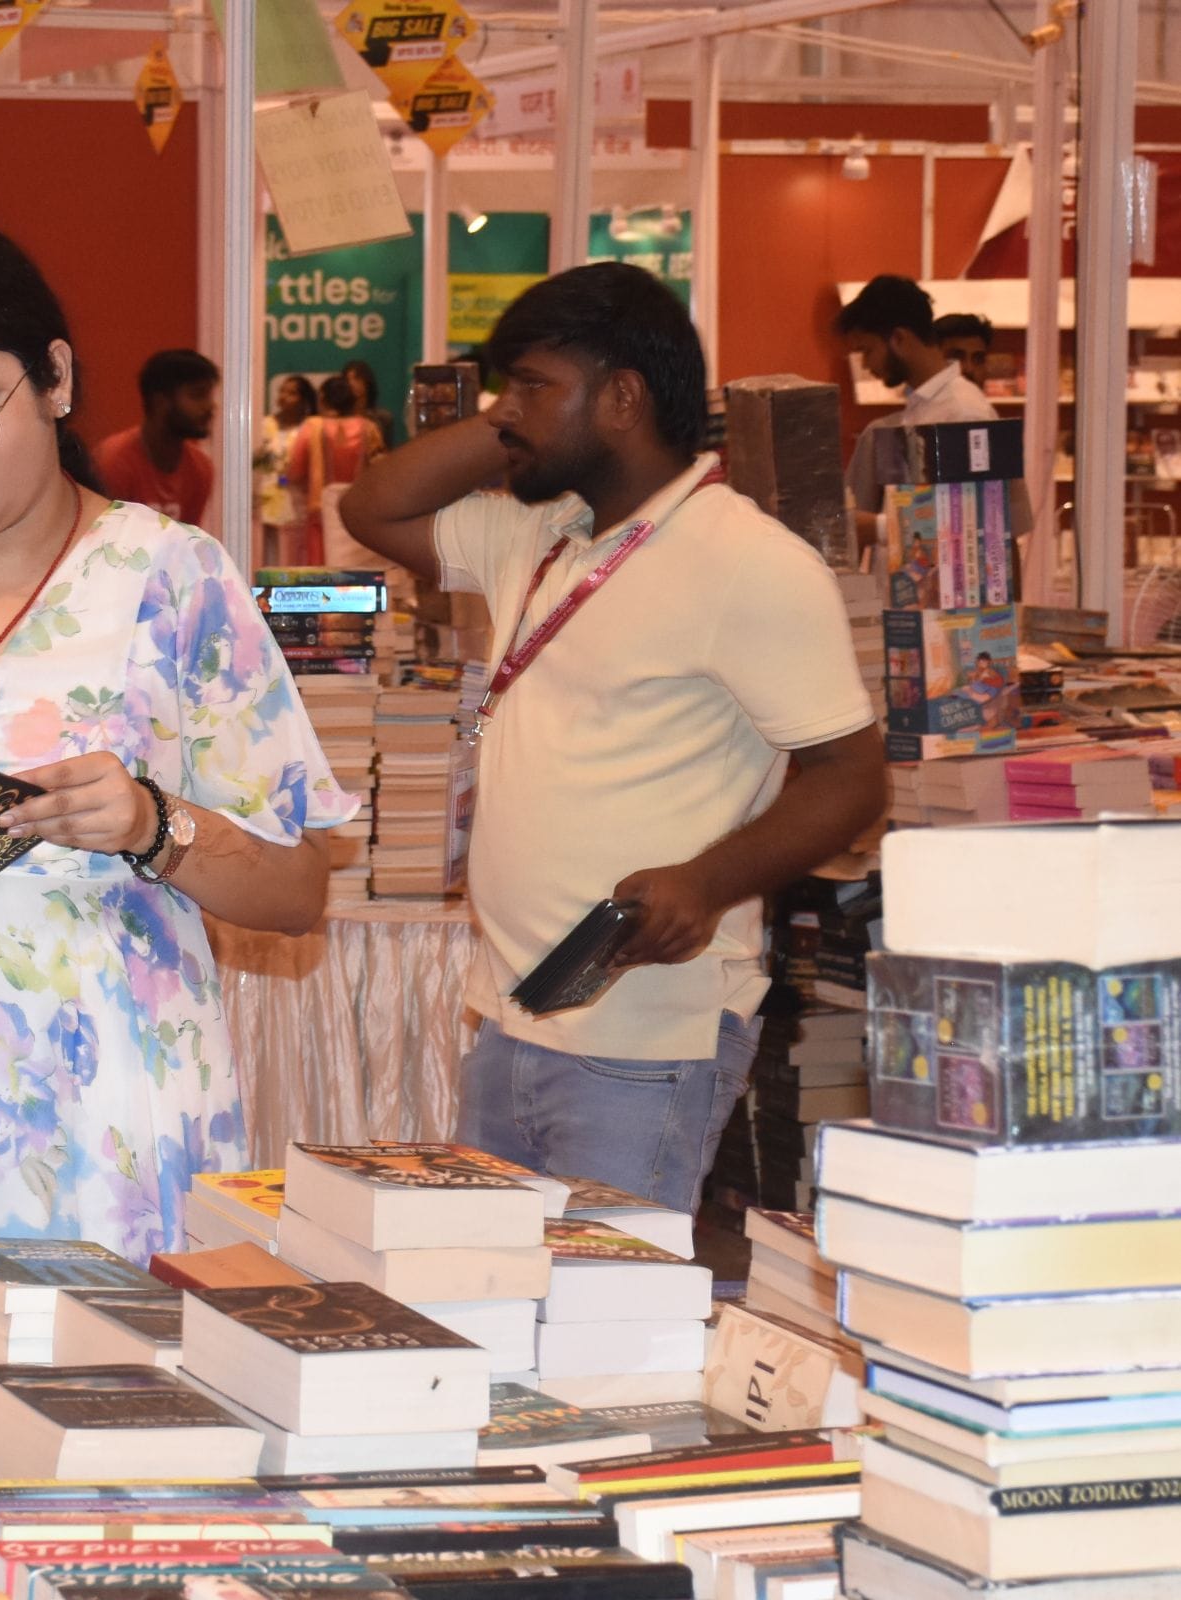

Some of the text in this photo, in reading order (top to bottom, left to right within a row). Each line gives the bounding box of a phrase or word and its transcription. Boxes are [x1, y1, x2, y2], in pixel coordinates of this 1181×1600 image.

[404, 16, 440, 38] SALE
[357, 1470, 471, 1482] CATCHING FIRE
[1001, 1479, 1181, 1510] MOON ZODIAC 202
[2, 1541, 305, 1559] STEPHEN KING
[512, 1546, 602, 1561] KING
[265, 1572, 362, 1588] KING
